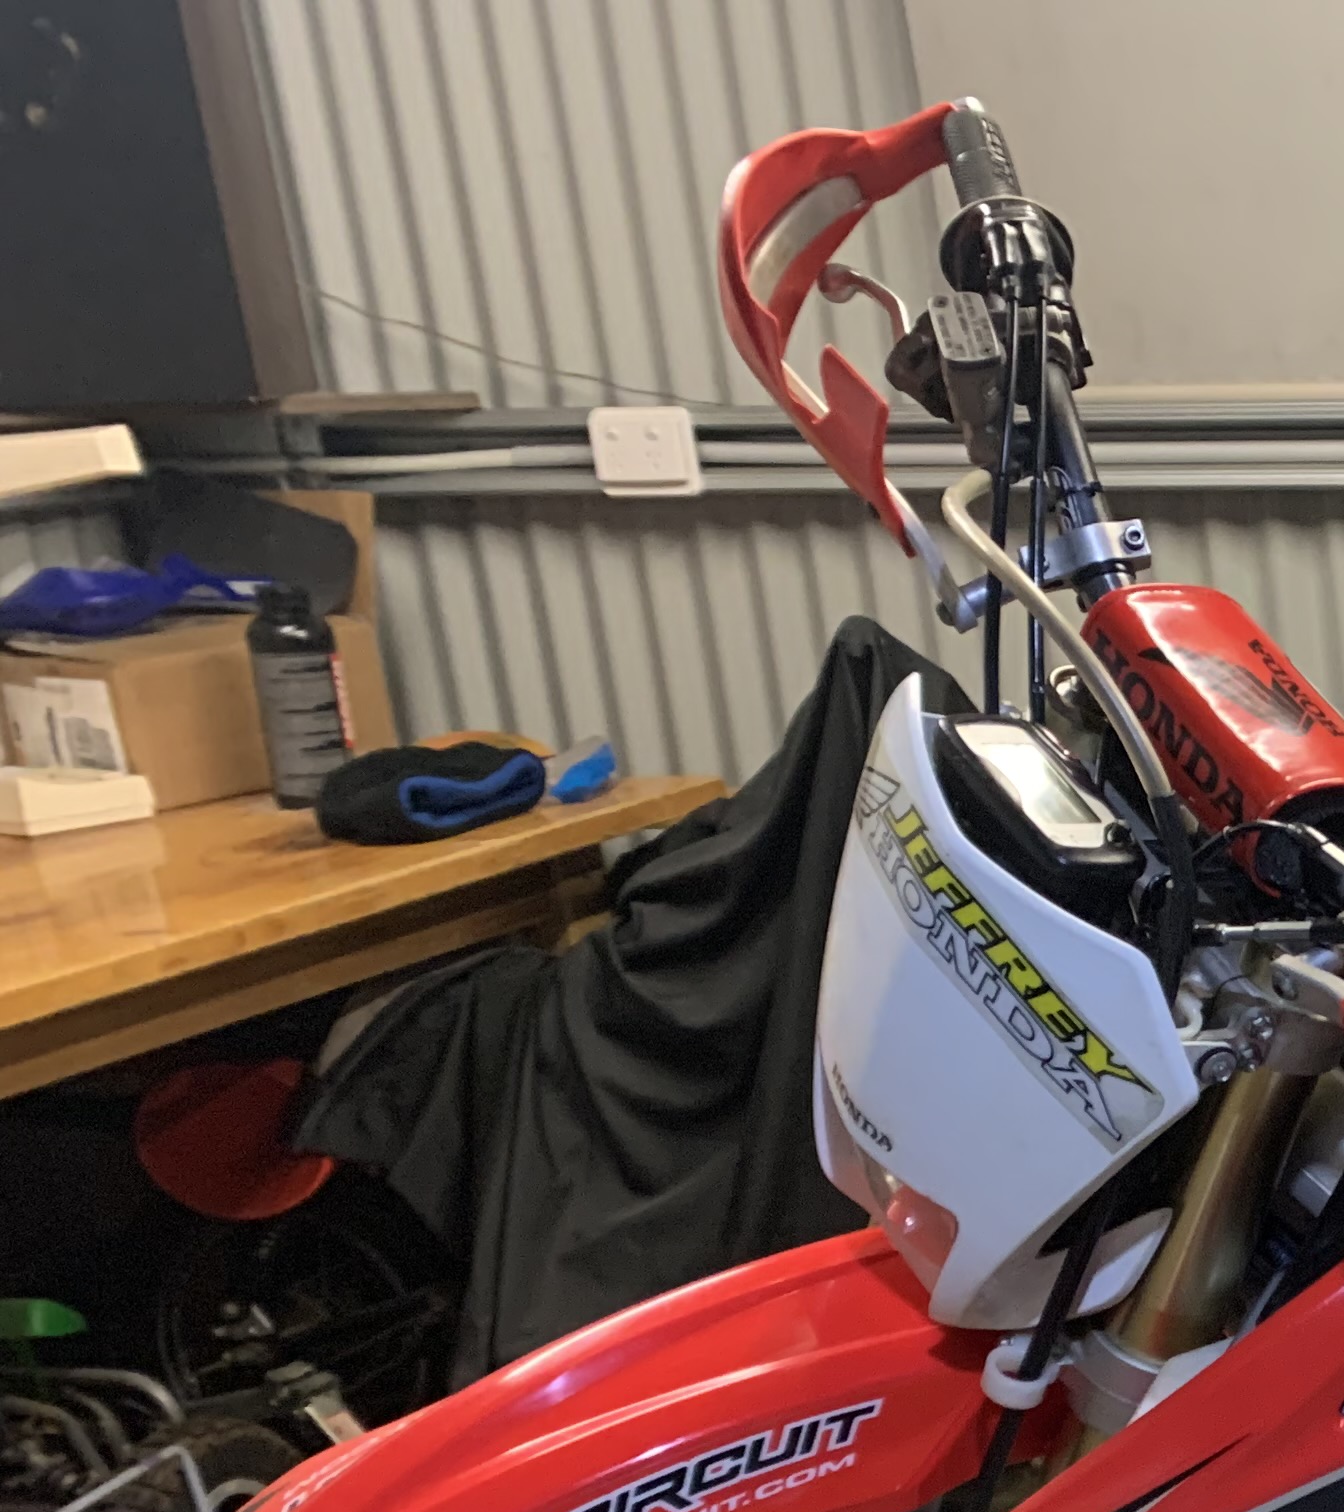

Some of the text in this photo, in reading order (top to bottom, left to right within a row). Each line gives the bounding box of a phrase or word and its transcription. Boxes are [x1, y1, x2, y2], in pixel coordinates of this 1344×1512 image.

[1091, 628, 1245, 827] HONDA
[869, 812, 1121, 1141] HONDA
[882, 805, 1153, 1093] JEFFREY
[831, 1061, 893, 1152] HONDA
